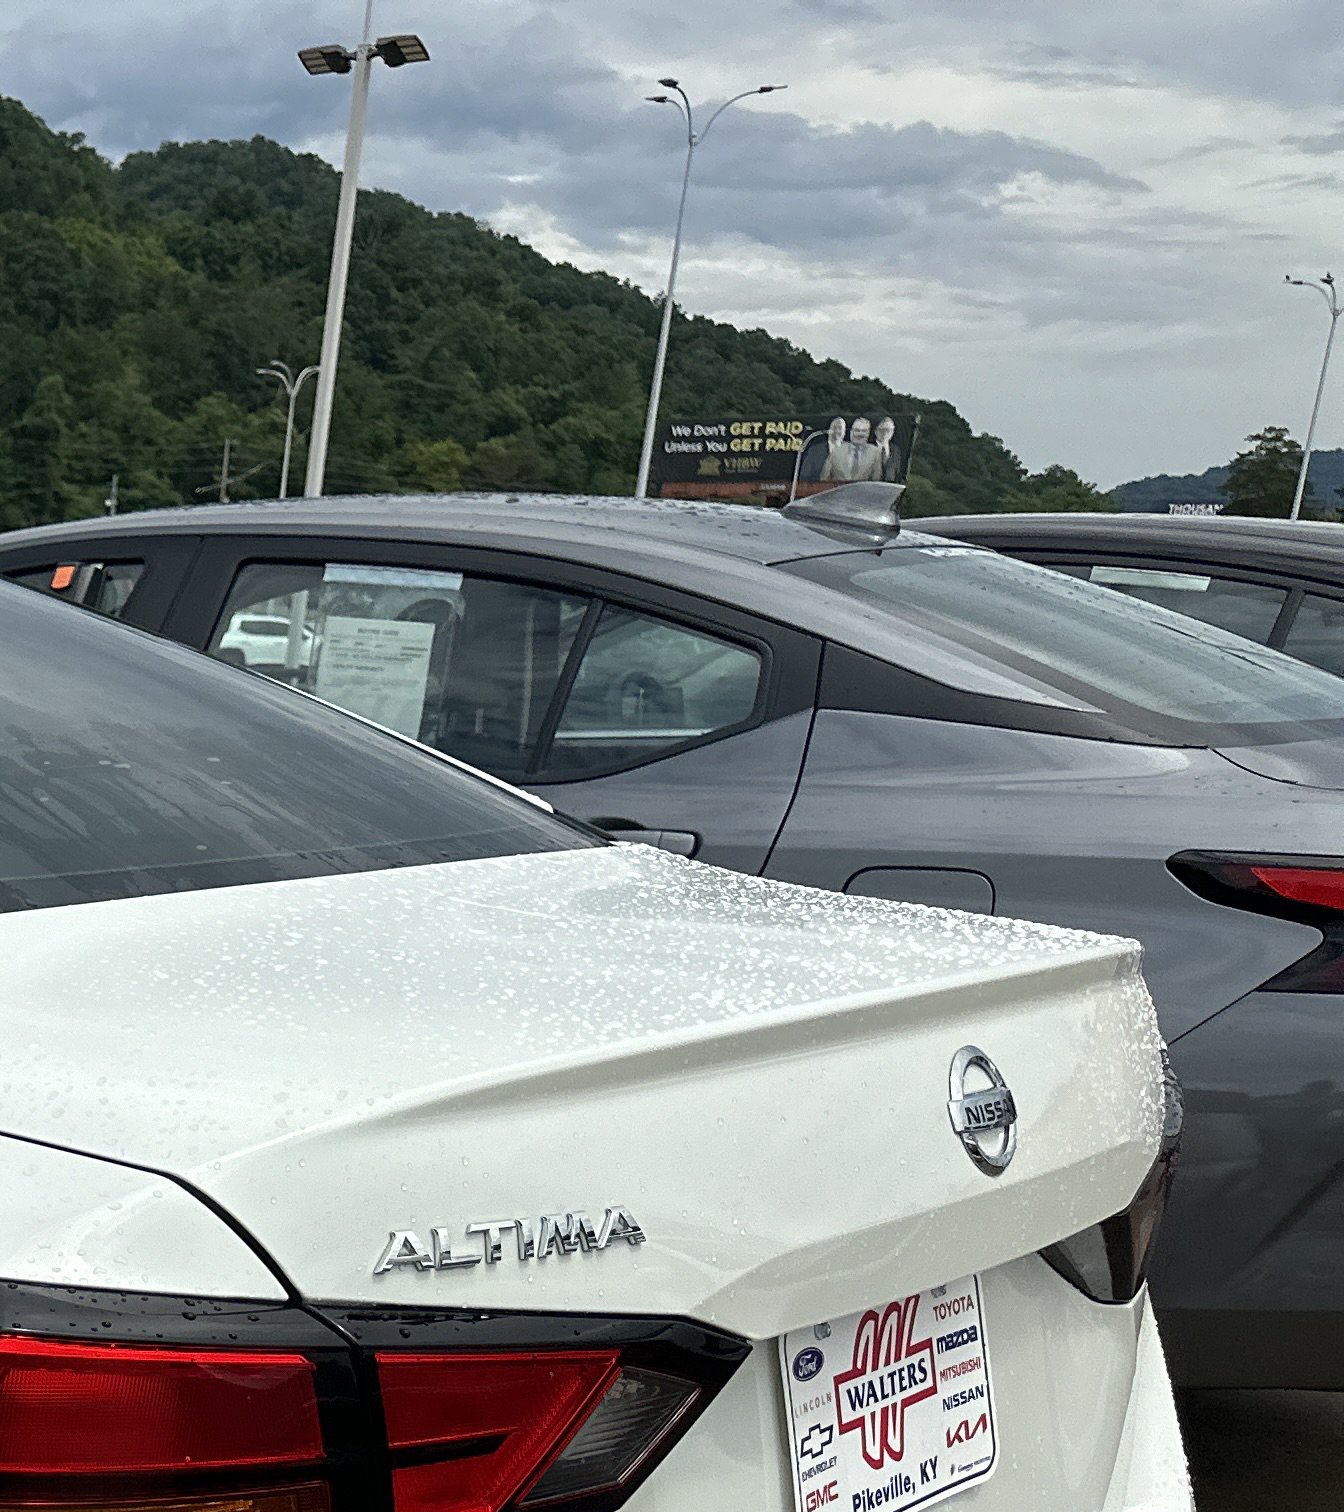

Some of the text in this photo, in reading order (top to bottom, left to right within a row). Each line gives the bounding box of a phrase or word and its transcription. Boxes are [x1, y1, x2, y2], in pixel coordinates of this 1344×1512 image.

[672, 421, 803, 438] We Don't GET PAID
[706, 440, 728, 453] You
[730, 438, 763, 453] GET
[765, 438, 803, 452] PAID
[964, 1097, 1014, 1126] NISSA
[373, 1205, 647, 1275] ALTIMA
[933, 1294, 974, 1322] TOYOTA
[939, 1356, 982, 1382] MITSUBISHI
[846, 1357, 928, 1412] WALTERS
[942, 1384, 985, 1412] NISSAN
[794, 1392, 832, 1418] LINCOLN
[801, 1456, 838, 1482] CHEVROLET
[919, 1455, 939, 1485] KY
[805, 1480, 839, 1512] GMC
